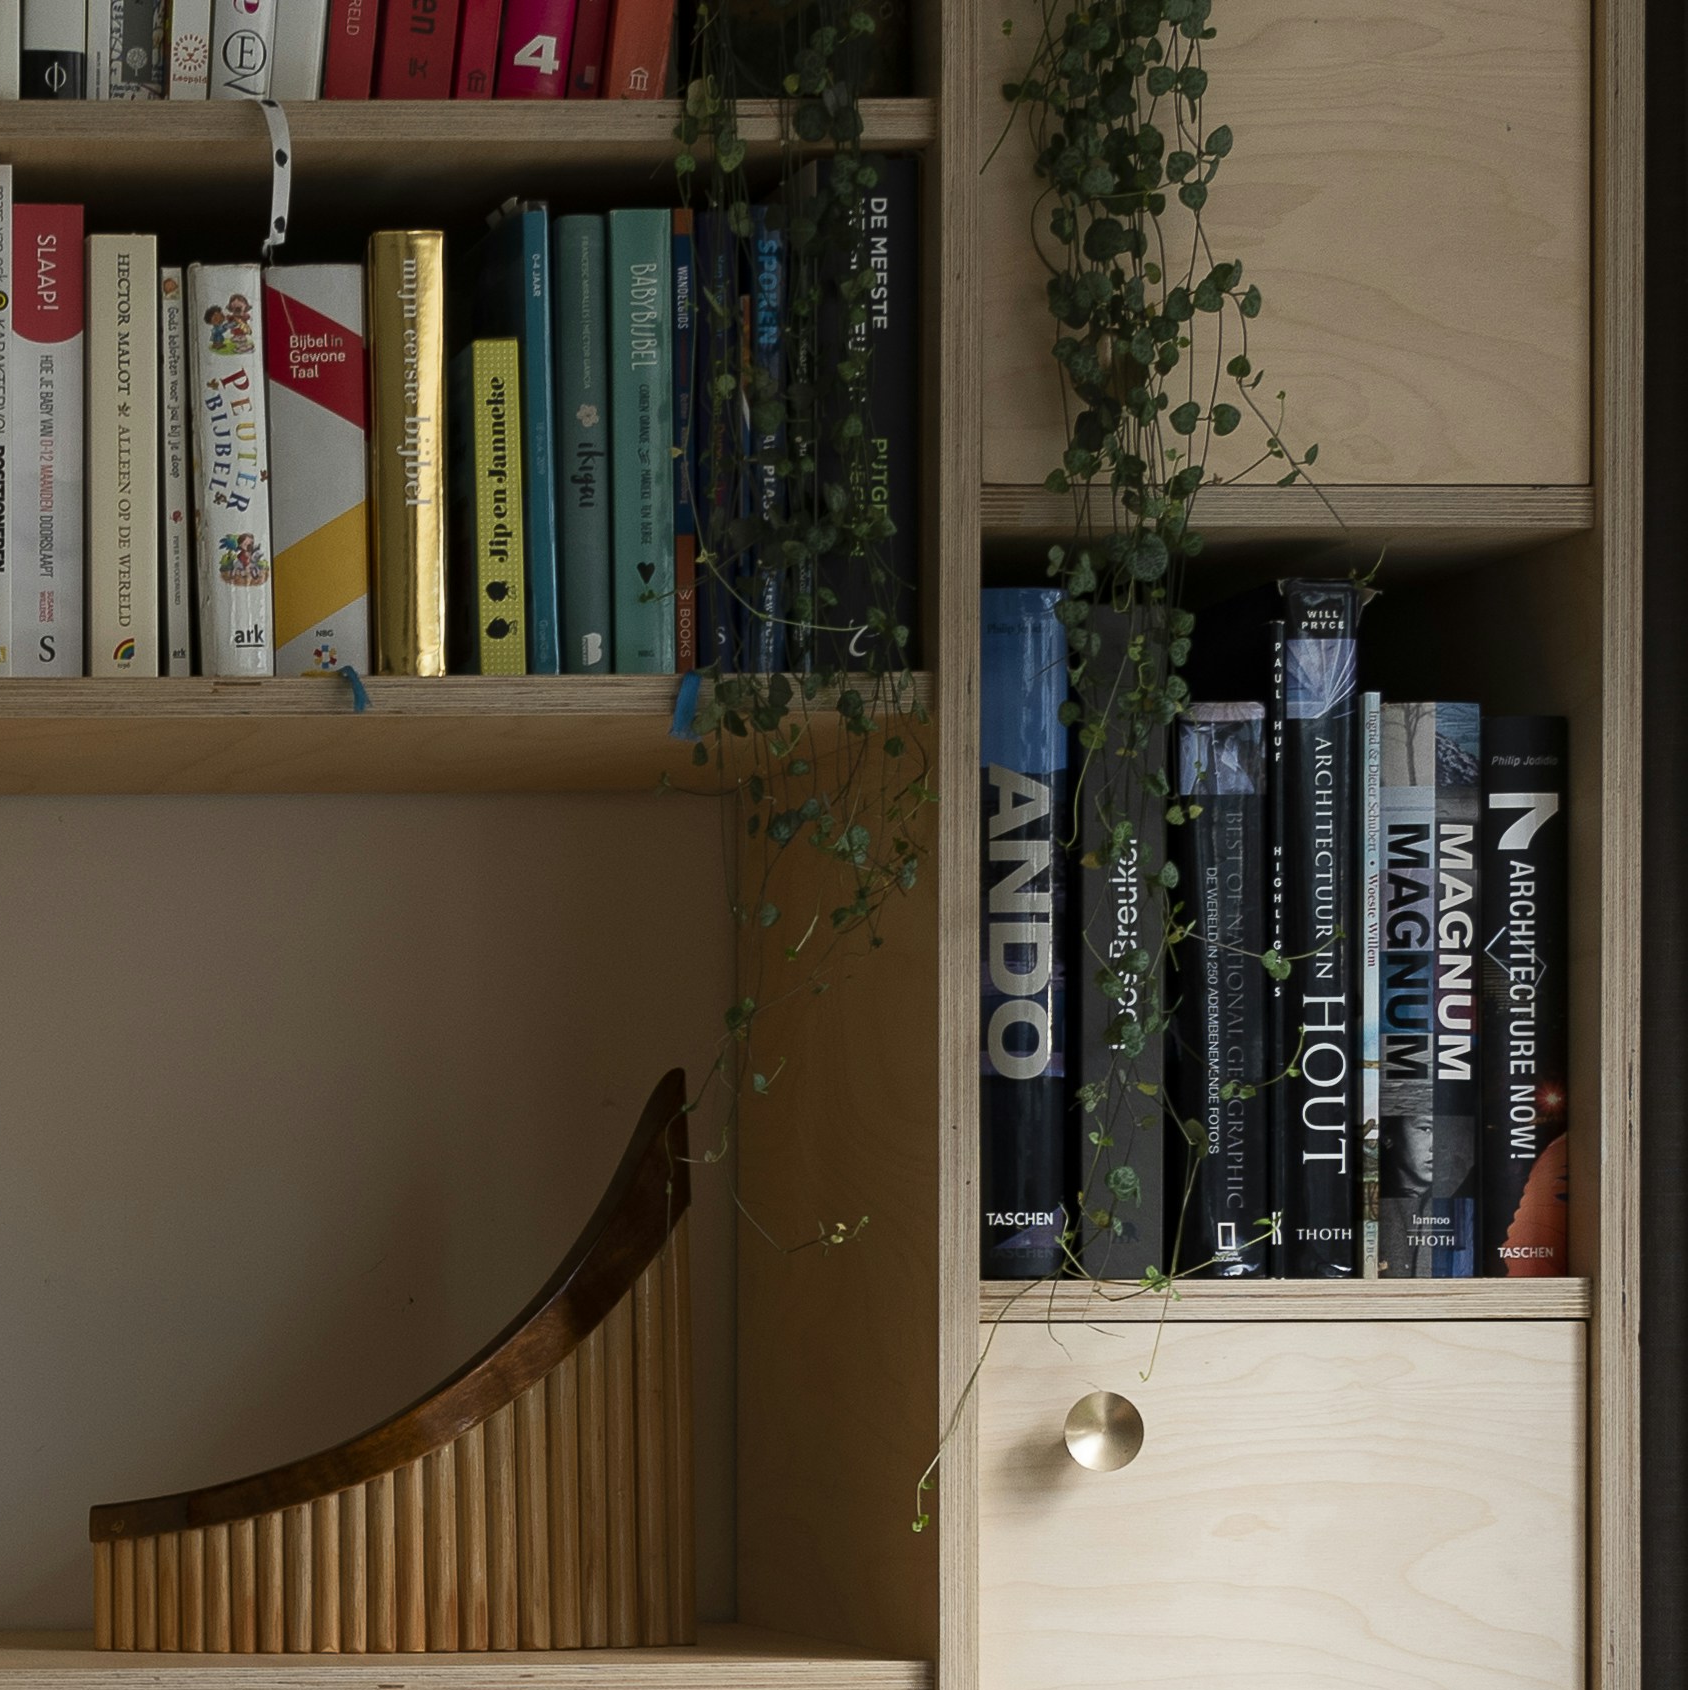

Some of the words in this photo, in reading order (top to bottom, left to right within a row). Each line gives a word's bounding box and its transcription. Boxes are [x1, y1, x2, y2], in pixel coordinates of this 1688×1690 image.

[513, 34, 560, 75] 4
[172, 72, 208, 85] Leopold
[36, 234, 60, 311] SLAAP!
[117, 253, 131, 326] HECTOR
[396, 259, 417, 318] mijn
[758, 239, 781, 345] SPOKEN
[630, 263, 658, 372] BABYBIJBEL
[677, 265, 689, 330] WANDELGIDS
[168, 306, 179, 331] Gods
[168, 334, 180, 377] beloften
[289, 335, 329, 351] Bijbel
[330, 335, 344, 347] in
[289, 350, 346, 364] Gewone
[39, 355, 53, 375] HOE
[39, 376, 53, 389] JE
[117, 332, 131, 396] MALOT
[289, 365, 319, 379] Taal
[403, 329, 419, 404] eerste
[39, 390, 54, 419] BABY
[170, 380, 181, 402] voor
[39, 420, 54, 438] VAN
[168, 404, 181, 422] jou
[168, 424, 182, 439] bij
[486, 376, 508, 484] Janneke
[39, 440, 54, 461] 0-12
[118, 426, 132, 494] ALLEEN
[168, 441, 181, 451] je
[205, 394, 232, 491] BIJBEL
[220, 368, 258, 512] PEUTER
[170, 454, 182, 479] doop
[396, 416, 432, 506] bijbel
[570, 442, 605, 508] ikigai
[39, 464, 54, 513] MAANDEN
[492, 489, 508, 519] en
[118, 498, 131, 523] OP
[39, 516, 54, 578] DOORSLAAPT
[118, 526, 131, 550] DE
[488, 523, 513, 563] Jip
[118, 553, 132, 628] WERELD
[234, 623, 264, 644] ark
[680, 608, 691, 658] BOOKS
[1301, 620, 1345, 630] PRYCE
[1307, 610, 1340, 619] WILL
[39, 635, 56, 663] S
[1274, 642, 1282, 700] PAUL
[1274, 720, 1282, 763] HUF
[1366, 710, 1380, 745] Ingrid
[1368, 748, 1378, 760] &
[1491, 755, 1521, 767] Philip
[1523, 755, 1560, 766] Jodidio
[1368, 763, 1379, 799] Dieter
[1314, 737, 1334, 939] ARCHITECTUUR
[1368, 801, 1379, 853] Schubert
[1488, 792, 1560, 851] 7
[1207, 867, 1218, 884] DE
[1207, 887, 1219, 942] WERELD
[1367, 874, 1379, 919] Woeste
[988, 761, 1053, 1080] ANDO
[1207, 945, 1219, 958] IN
[1315, 951, 1334, 980] IN
[1367, 923, 1379, 968] Willem
[1386, 823, 1431, 1080] MAGNUM
[1437, 823, 1473, 1081] MAGNUM
[1207, 961, 1220, 985] 250
[1509, 859, 1536, 1076] ARCHITECTURE
[1301, 993, 1347, 1175] HOUT
[1208, 1107, 1220, 1154] FOTO'S
[1510, 1084, 1537, 1160] NOW!
[986, 1212, 1054, 1226] TASCHEN
[1296, 1228, 1353, 1241] THOTH
[1412, 1213, 1451, 1226] lannoo
[1406, 1235, 1455, 1247] THOTH
[1497, 1246, 1554, 1259] TASCHEN
